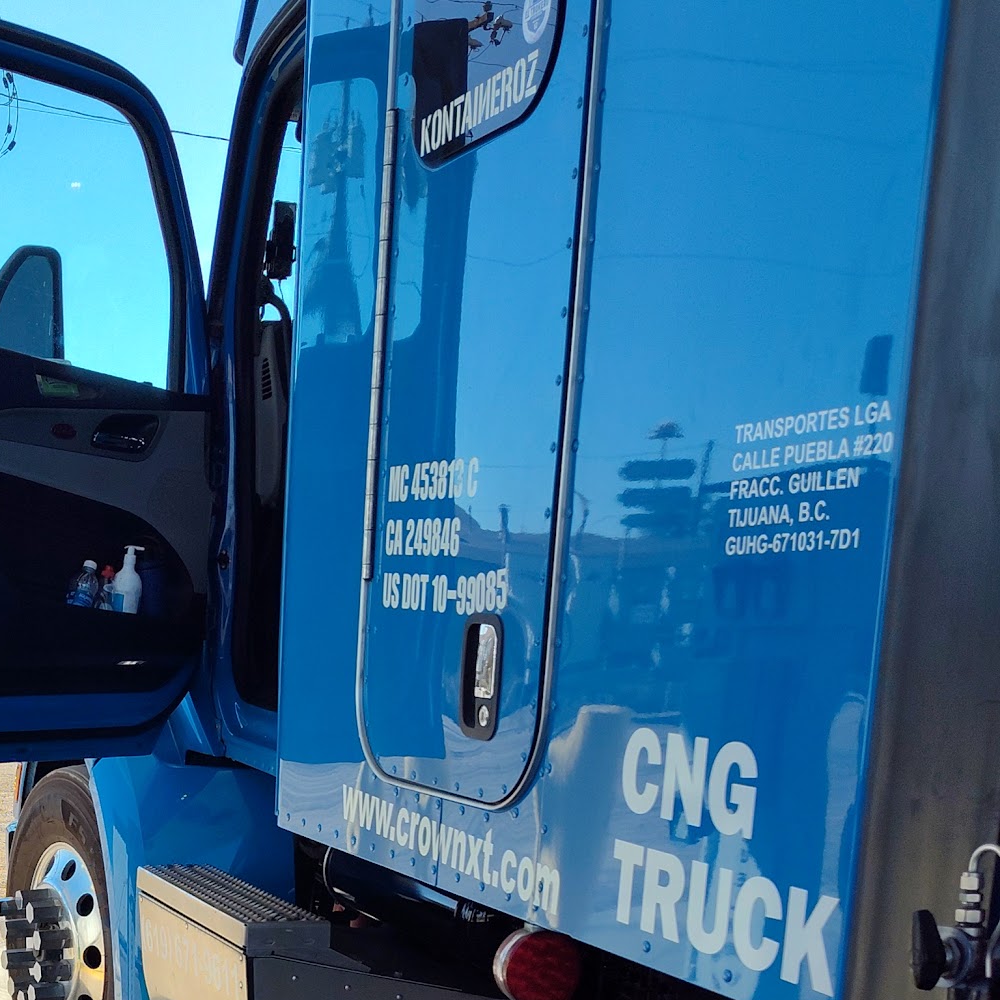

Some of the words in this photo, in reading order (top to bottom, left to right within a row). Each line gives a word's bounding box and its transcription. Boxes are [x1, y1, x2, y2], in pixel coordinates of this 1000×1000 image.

[735, 406, 850, 444] TRANSPORTES
[854, 400, 892, 426] LGA
[732, 447, 781, 472] CALLE
[783, 438, 850, 466] PUEBLA
[853, 431, 894, 457] #220
[388, 464, 410, 502] MC
[411, 457, 465, 501] 453813
[467, 456, 479, 498] C
[729, 475, 784, 500] FRACC.
[788, 466, 861, 494] GUILLEN
[728, 504, 794, 528] TIJUANA,
[798, 500, 830, 523] B.C.
[385, 518, 403, 556] CA
[405, 517, 461, 558] 249846
[725, 528, 861, 556] GUHG-671031-7D1
[382, 572, 400, 610] US
[401, 573, 430, 612] DOT
[432, 567, 509, 616] 10-99085
[622, 727, 759, 840] CNG
[342, 783, 561, 916] www.crownxt.com
[613, 838, 841, 998] TRUCK
